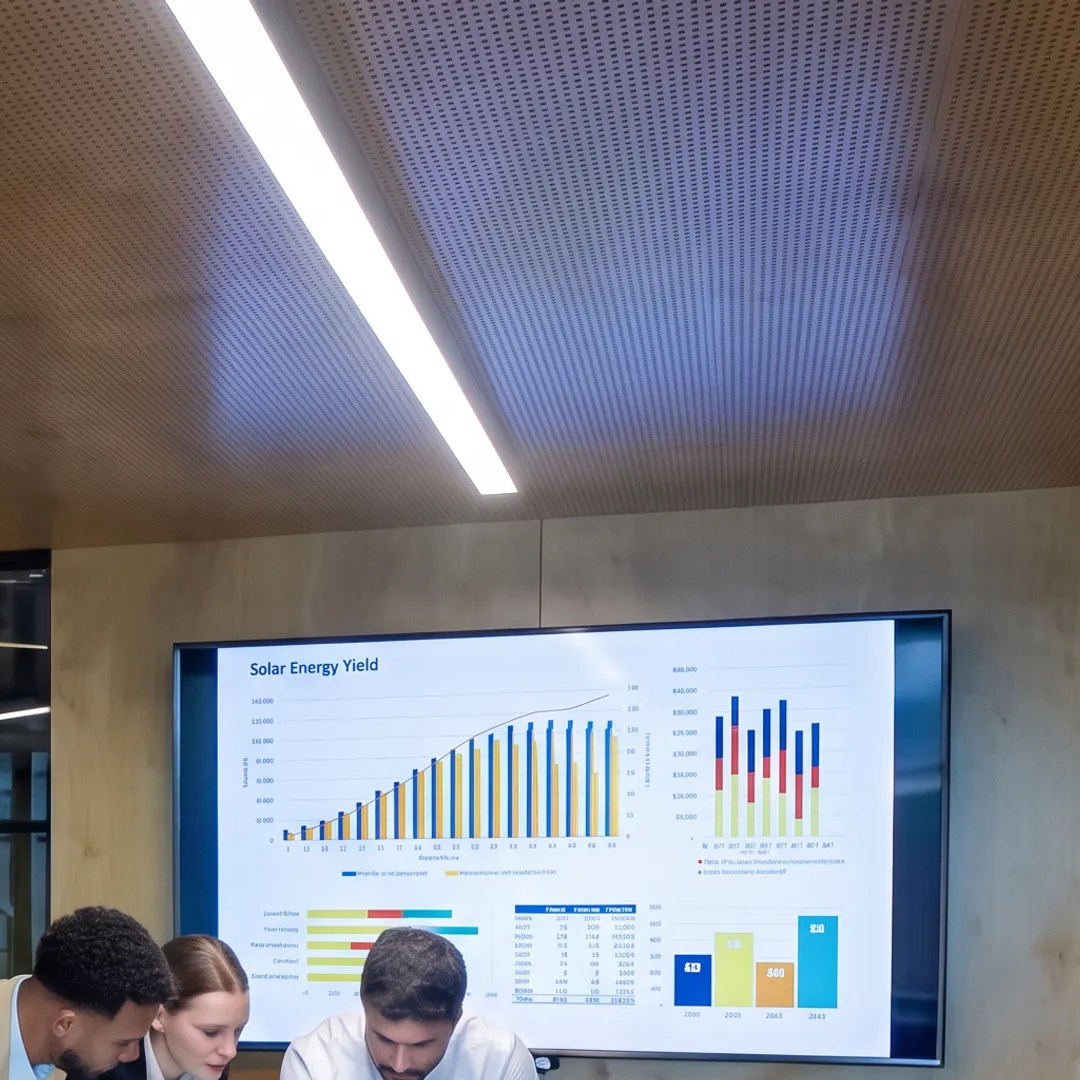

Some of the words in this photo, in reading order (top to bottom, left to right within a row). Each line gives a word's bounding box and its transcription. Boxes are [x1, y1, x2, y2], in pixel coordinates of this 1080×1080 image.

[250, 662, 286, 676] Solar
[290, 661, 339, 676] Energy
[343, 657, 379, 672] Yield
